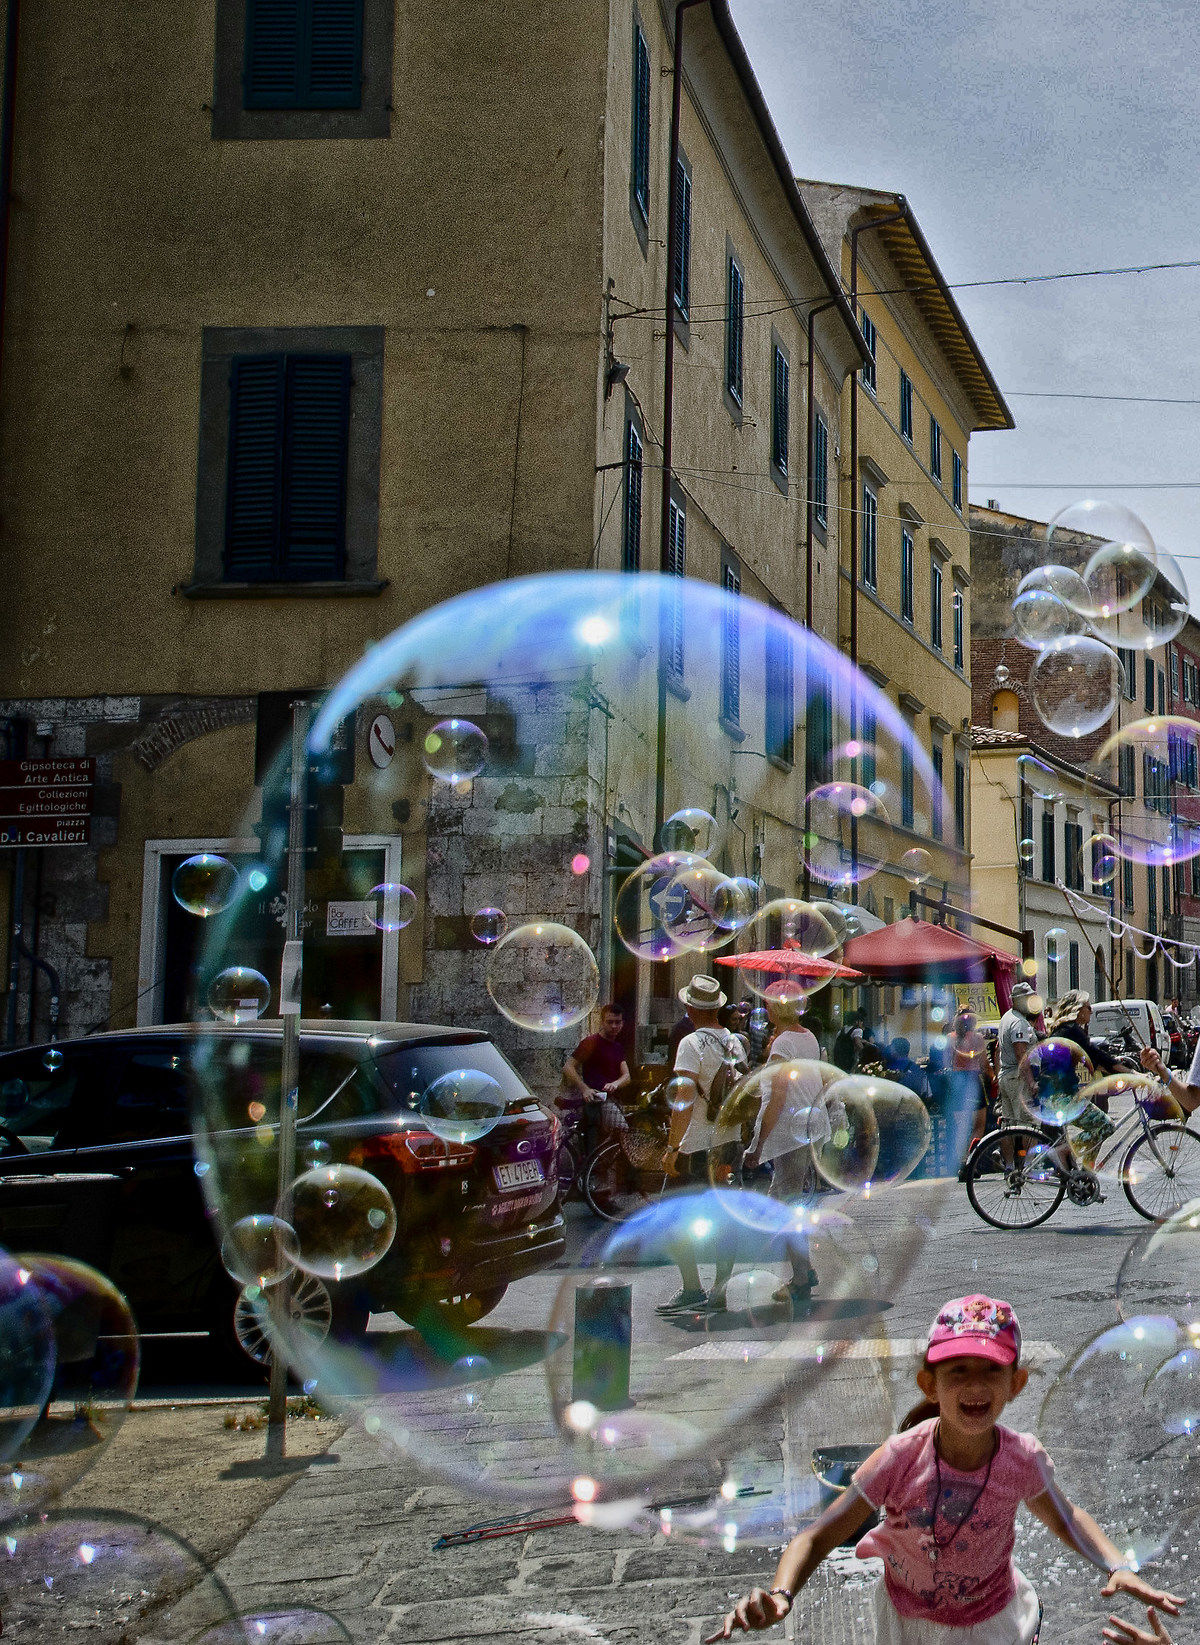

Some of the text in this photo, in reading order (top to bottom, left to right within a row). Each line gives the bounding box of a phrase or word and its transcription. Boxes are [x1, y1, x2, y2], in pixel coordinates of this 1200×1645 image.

[20, 760, 90, 771] Gipsoteca di
[24, 773, 89, 783] Arte Antica
[38, 790, 88, 799] Collezioni
[19, 802, 87, 813] Egittologiche
[1, 829, 85, 843] Di Cavalieri
[331, 908, 345, 918] Bar
